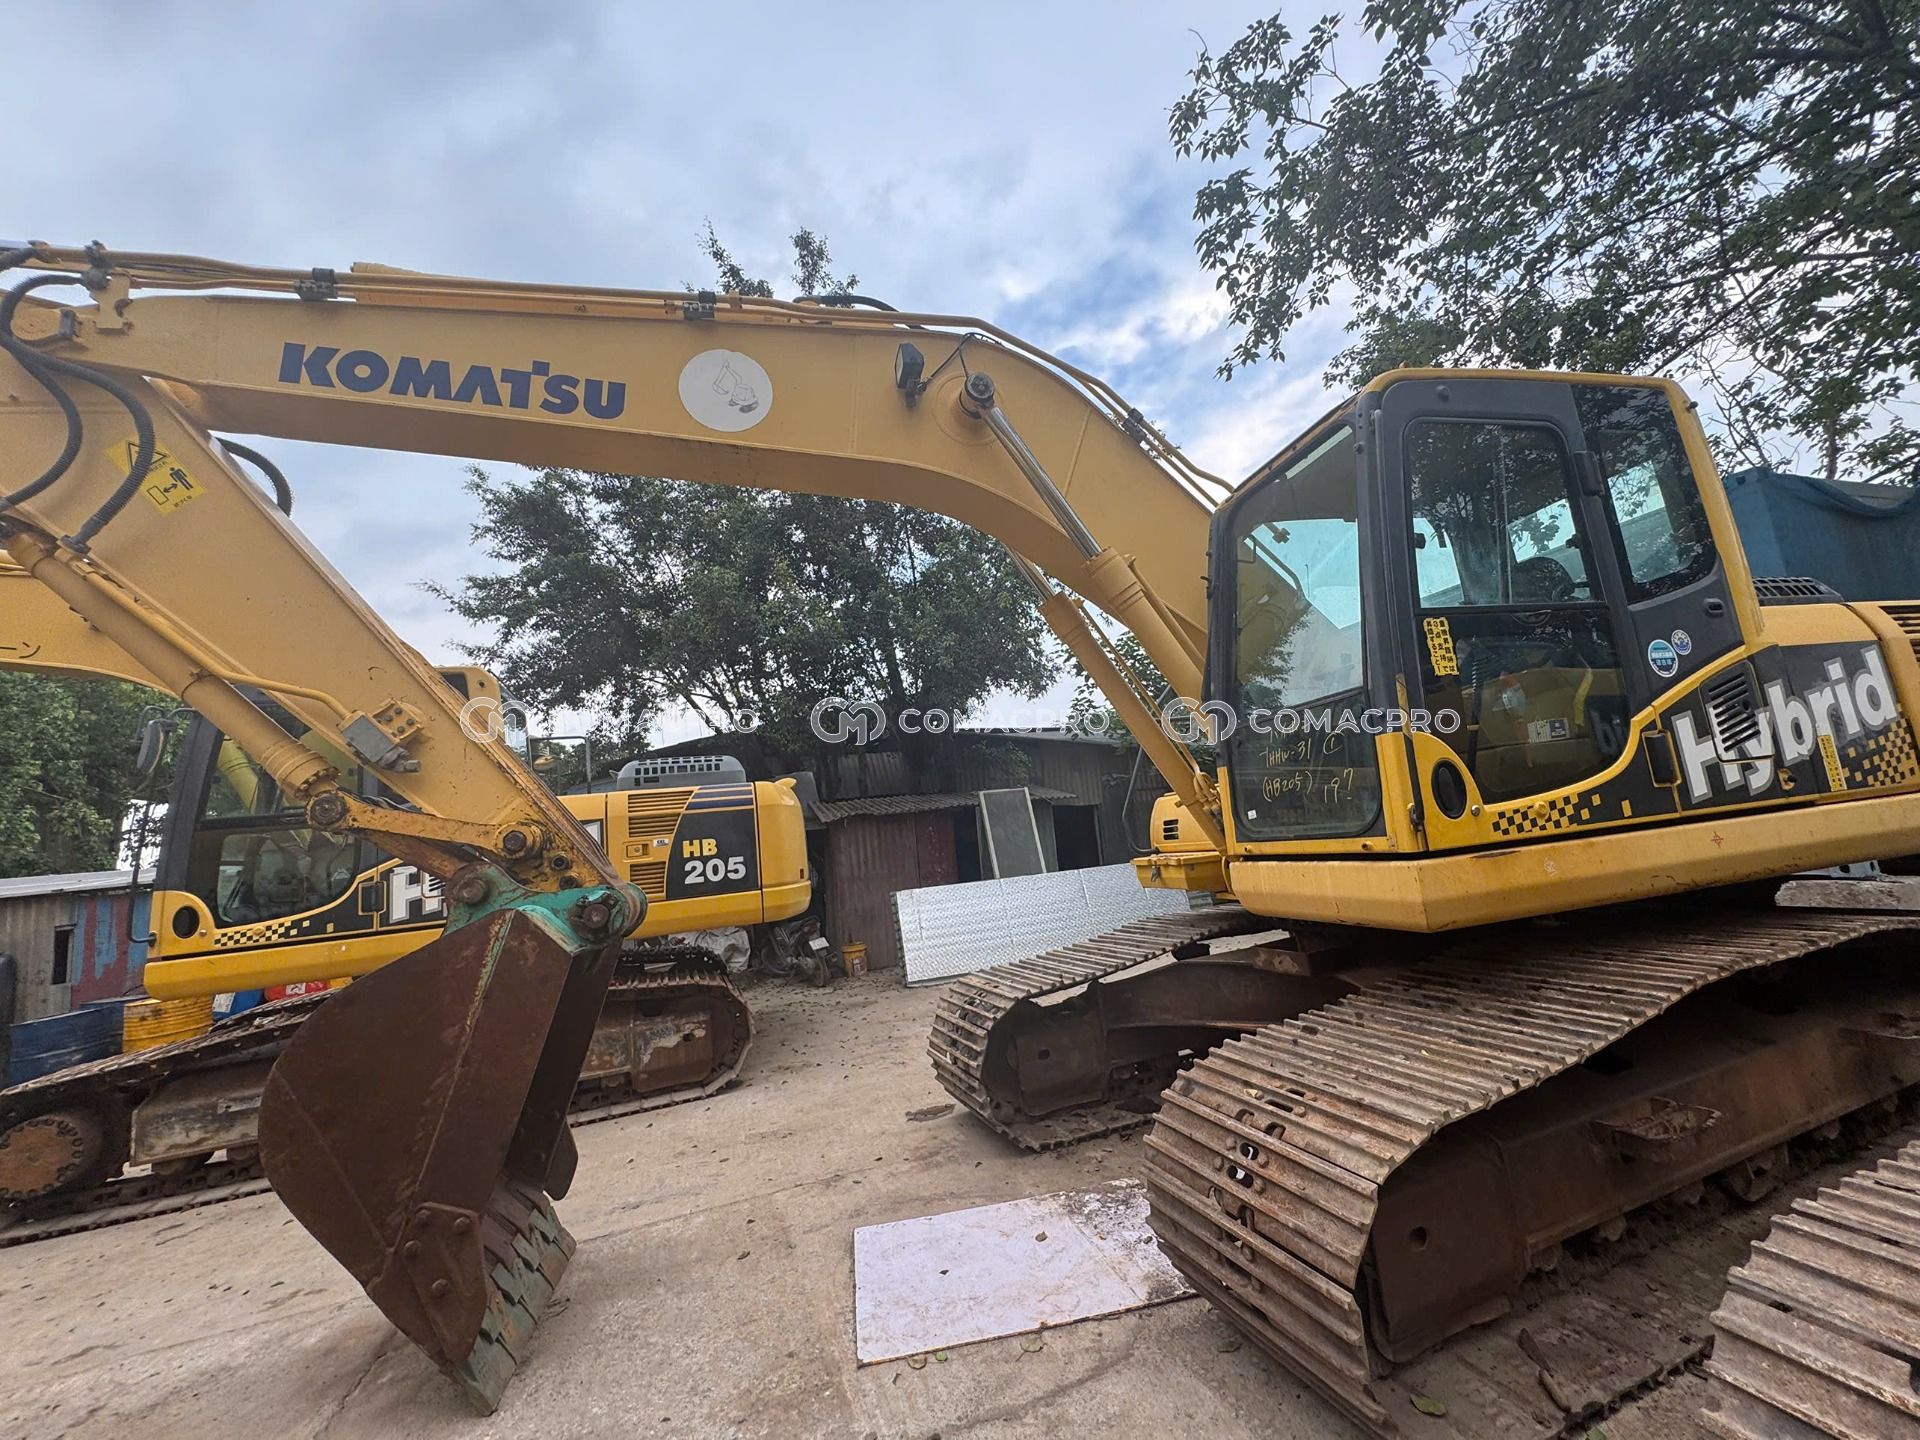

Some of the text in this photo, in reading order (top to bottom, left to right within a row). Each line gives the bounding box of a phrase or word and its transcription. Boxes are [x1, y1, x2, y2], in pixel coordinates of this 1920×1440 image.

[278, 342, 626, 420] KOMATSU
[1671, 646, 1898, 805] Hybrid
[682, 838, 718, 858] HB
[684, 856, 747, 885] 205
